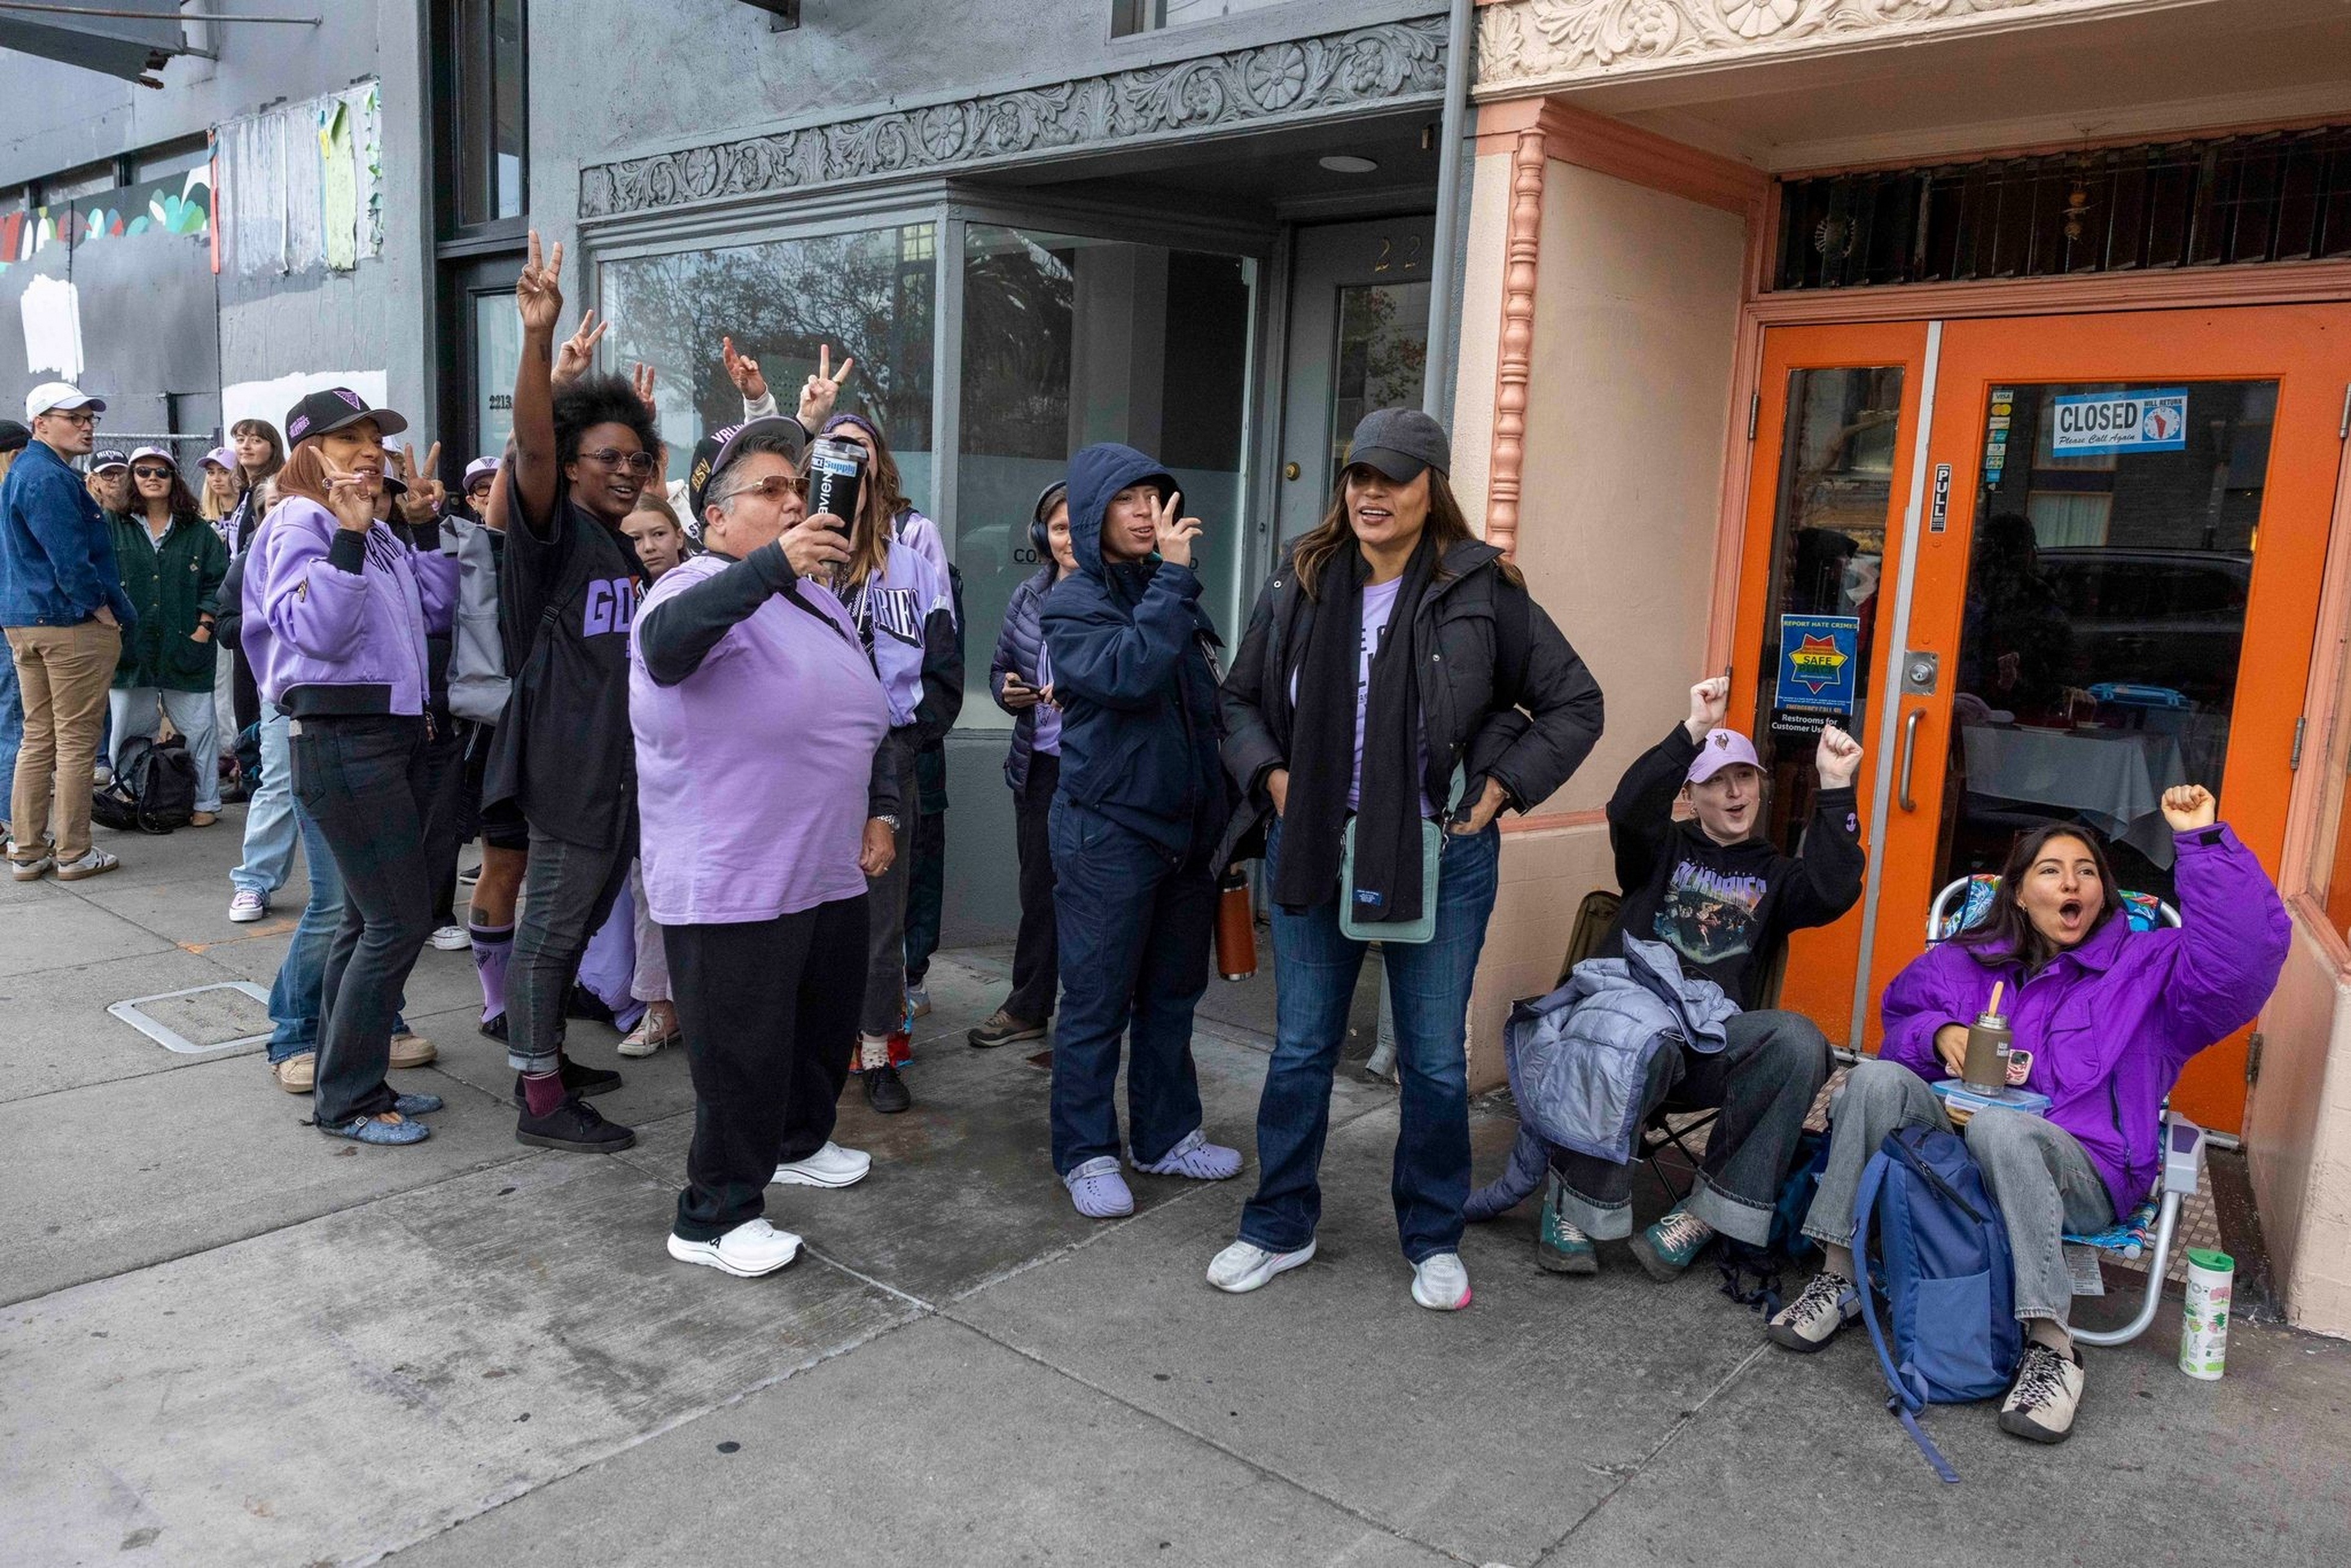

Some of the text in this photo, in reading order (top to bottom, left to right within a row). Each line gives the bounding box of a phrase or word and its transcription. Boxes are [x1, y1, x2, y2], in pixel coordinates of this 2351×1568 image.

[2060, 402, 2138, 433] CLOSED
[2058, 433, 2135, 445] Please Call Again
[825, 460, 856, 476] Supply
[1935, 470, 1948, 516] PULL
[1804, 656, 1832, 666] SAFE
[1782, 714, 1838, 726] Restrooms for
[1771, 722, 1810, 732] Customer
